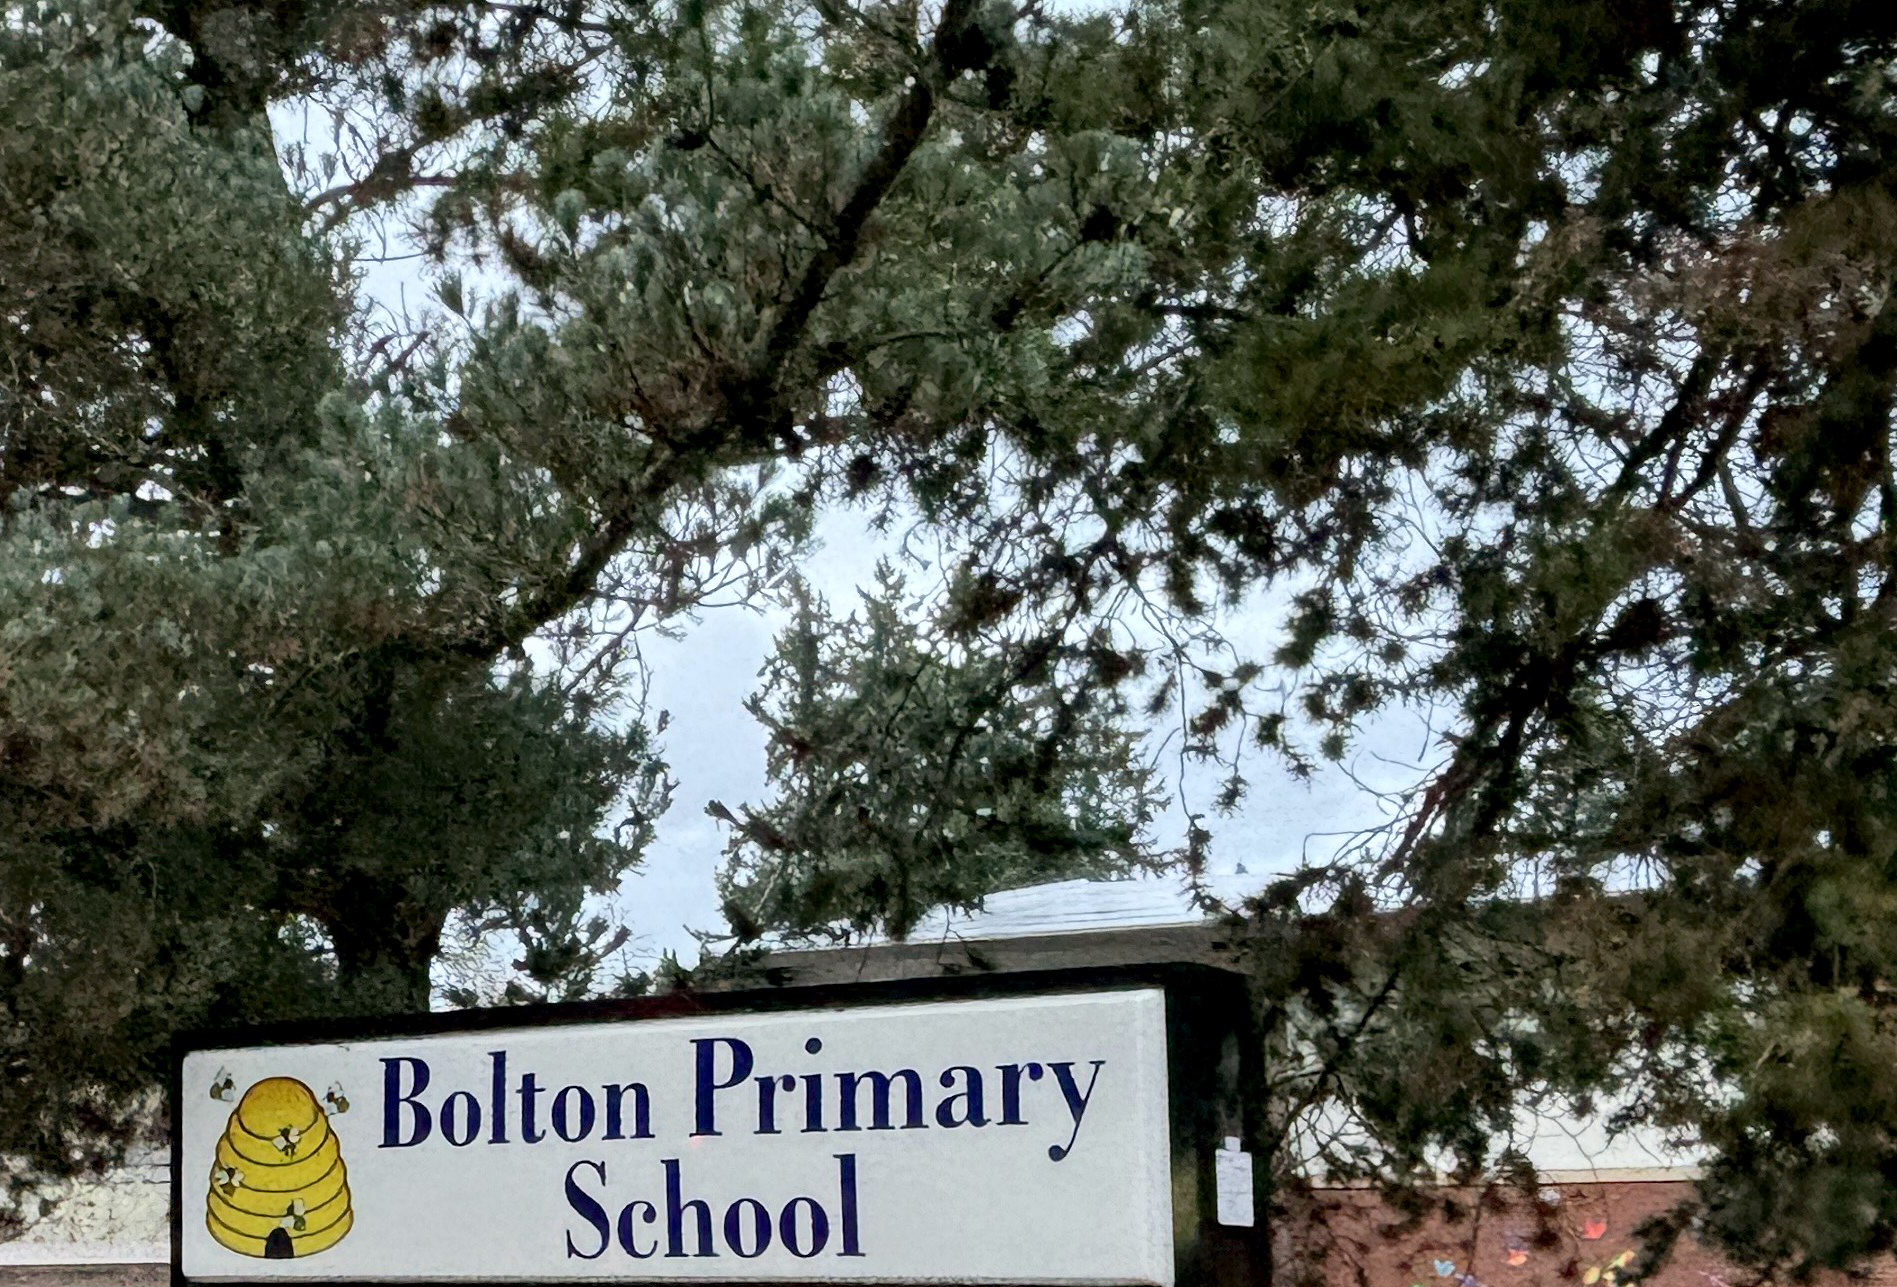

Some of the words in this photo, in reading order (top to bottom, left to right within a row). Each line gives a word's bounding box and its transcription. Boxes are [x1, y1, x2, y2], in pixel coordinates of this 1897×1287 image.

[378, 1049, 655, 1150] Bolton
[689, 1035, 1106, 1160] Primary
[564, 1153, 867, 1260] School
